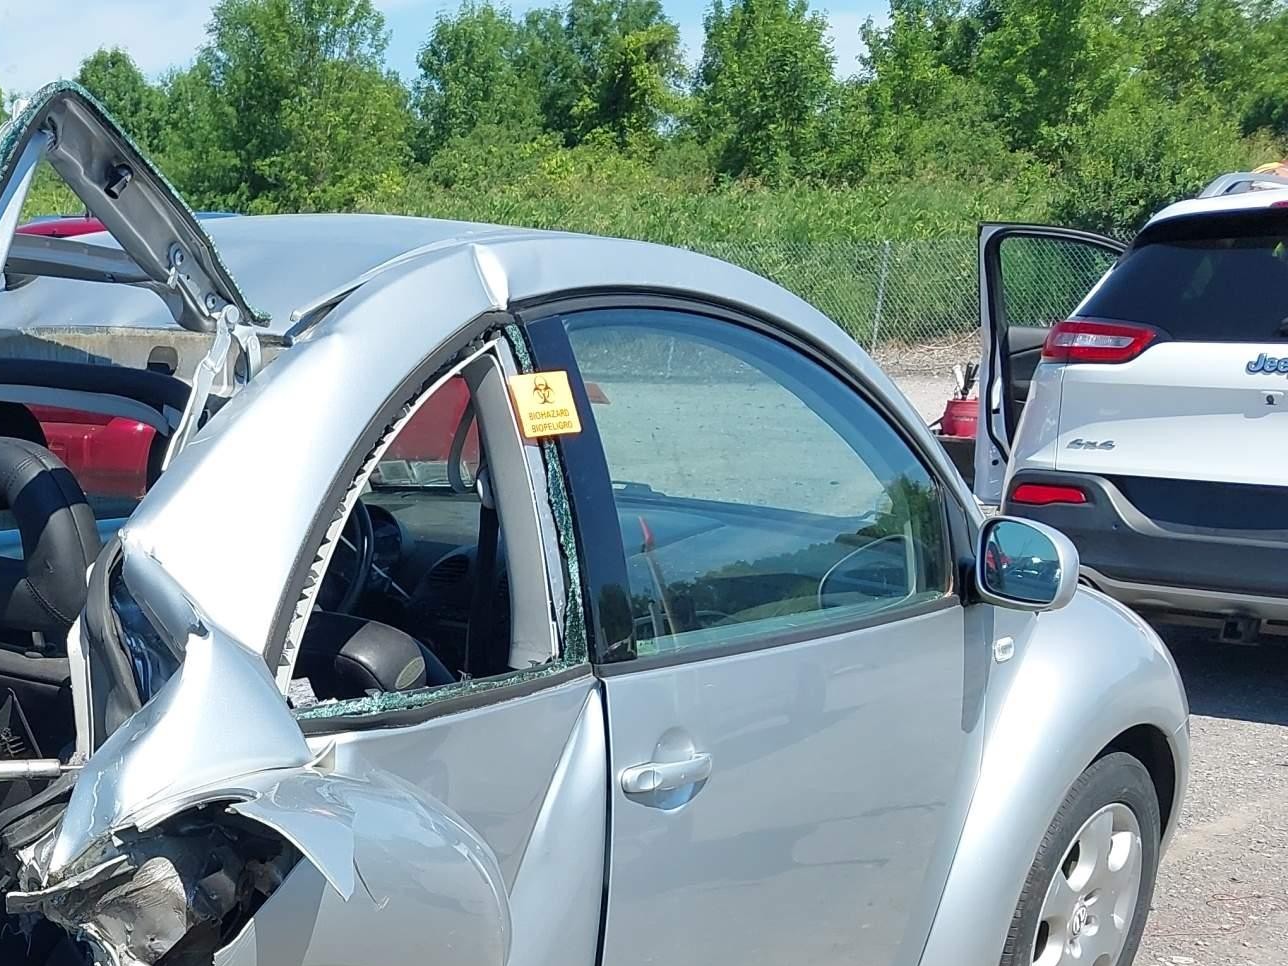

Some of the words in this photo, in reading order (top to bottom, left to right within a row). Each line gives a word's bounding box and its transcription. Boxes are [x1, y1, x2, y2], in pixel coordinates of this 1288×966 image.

[1246, 352, 1288, 375] Jee
[528, 408, 570, 421] BIOHAZARD
[532, 421, 573, 433] BIOPELIGRO
